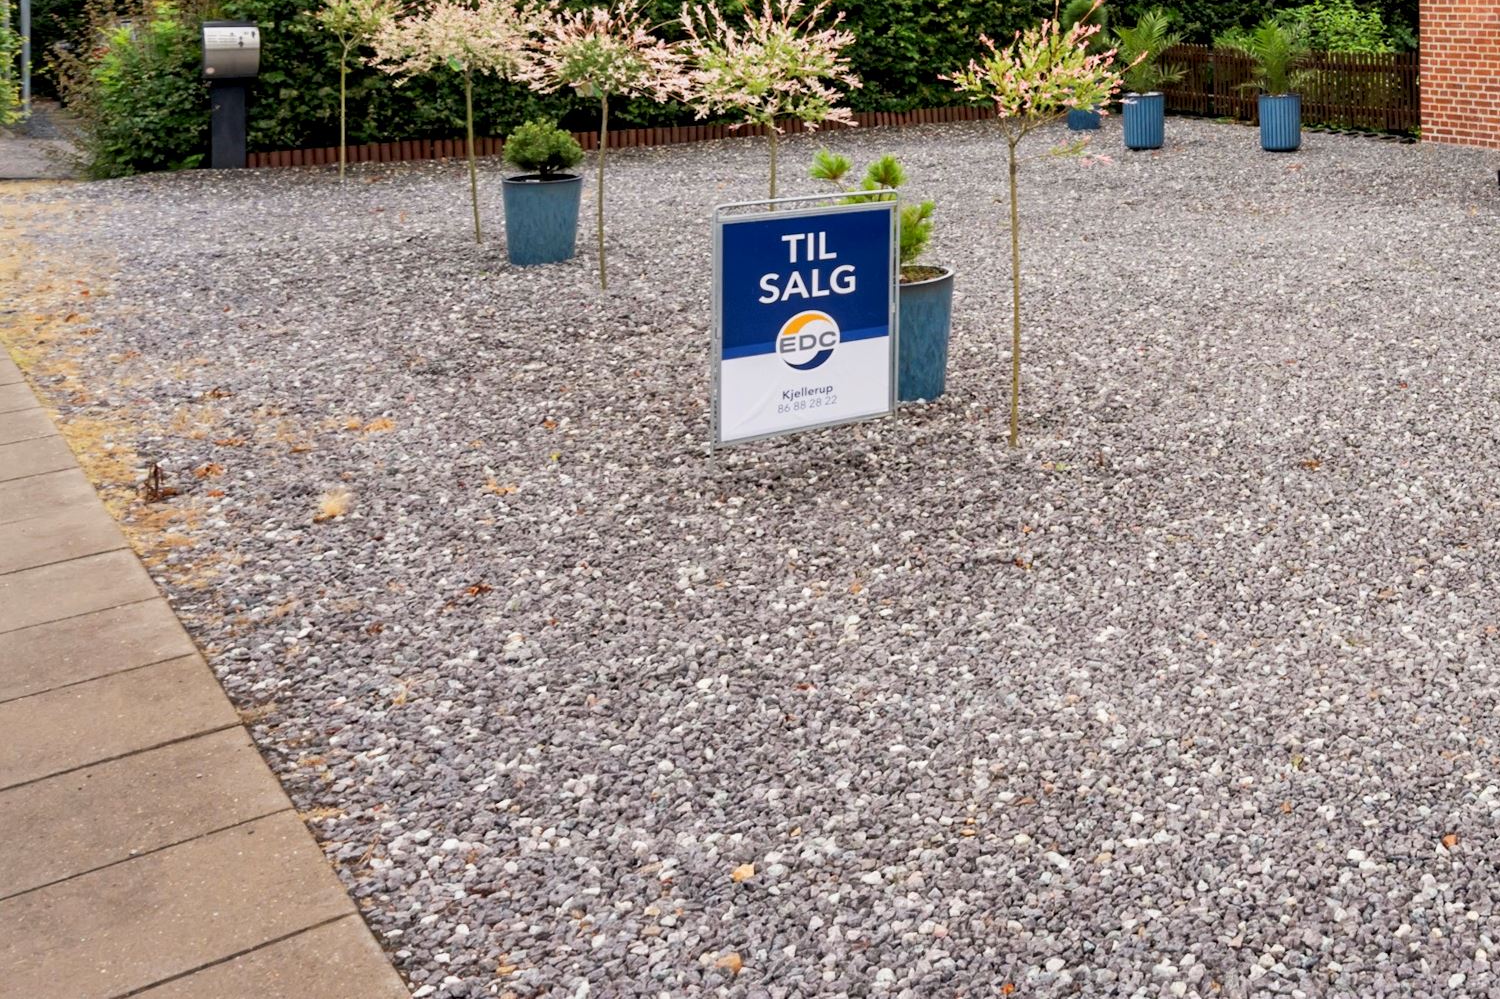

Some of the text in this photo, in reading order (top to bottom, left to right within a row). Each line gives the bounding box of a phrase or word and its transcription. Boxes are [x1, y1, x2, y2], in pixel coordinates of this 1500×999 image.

[781, 231, 837, 263] TIL
[758, 264, 856, 304] SALG
[779, 331, 837, 354] EDC
[777, 395, 837, 414] 86 88 28 22
[782, 385, 833, 401] Kjellerup
